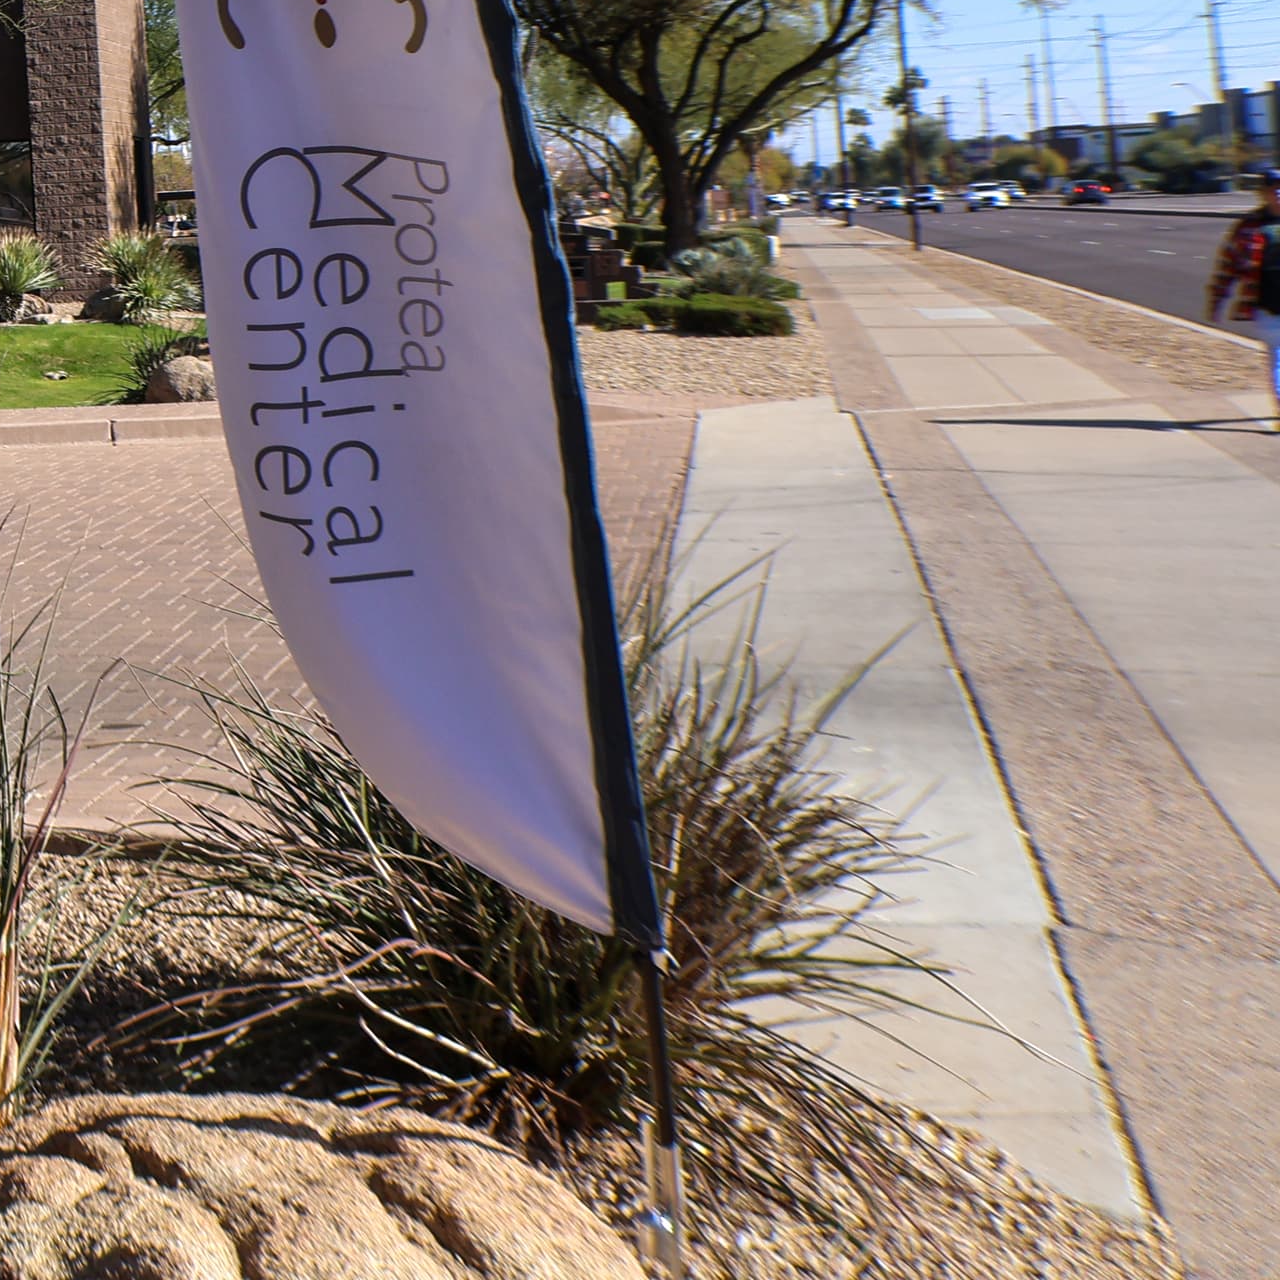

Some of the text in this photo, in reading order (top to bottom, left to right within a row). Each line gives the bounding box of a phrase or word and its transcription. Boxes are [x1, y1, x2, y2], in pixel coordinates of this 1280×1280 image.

[241, 147, 326, 556] Center
[303, 145, 414, 584] Medical
[387, 152, 454, 377] Protea
